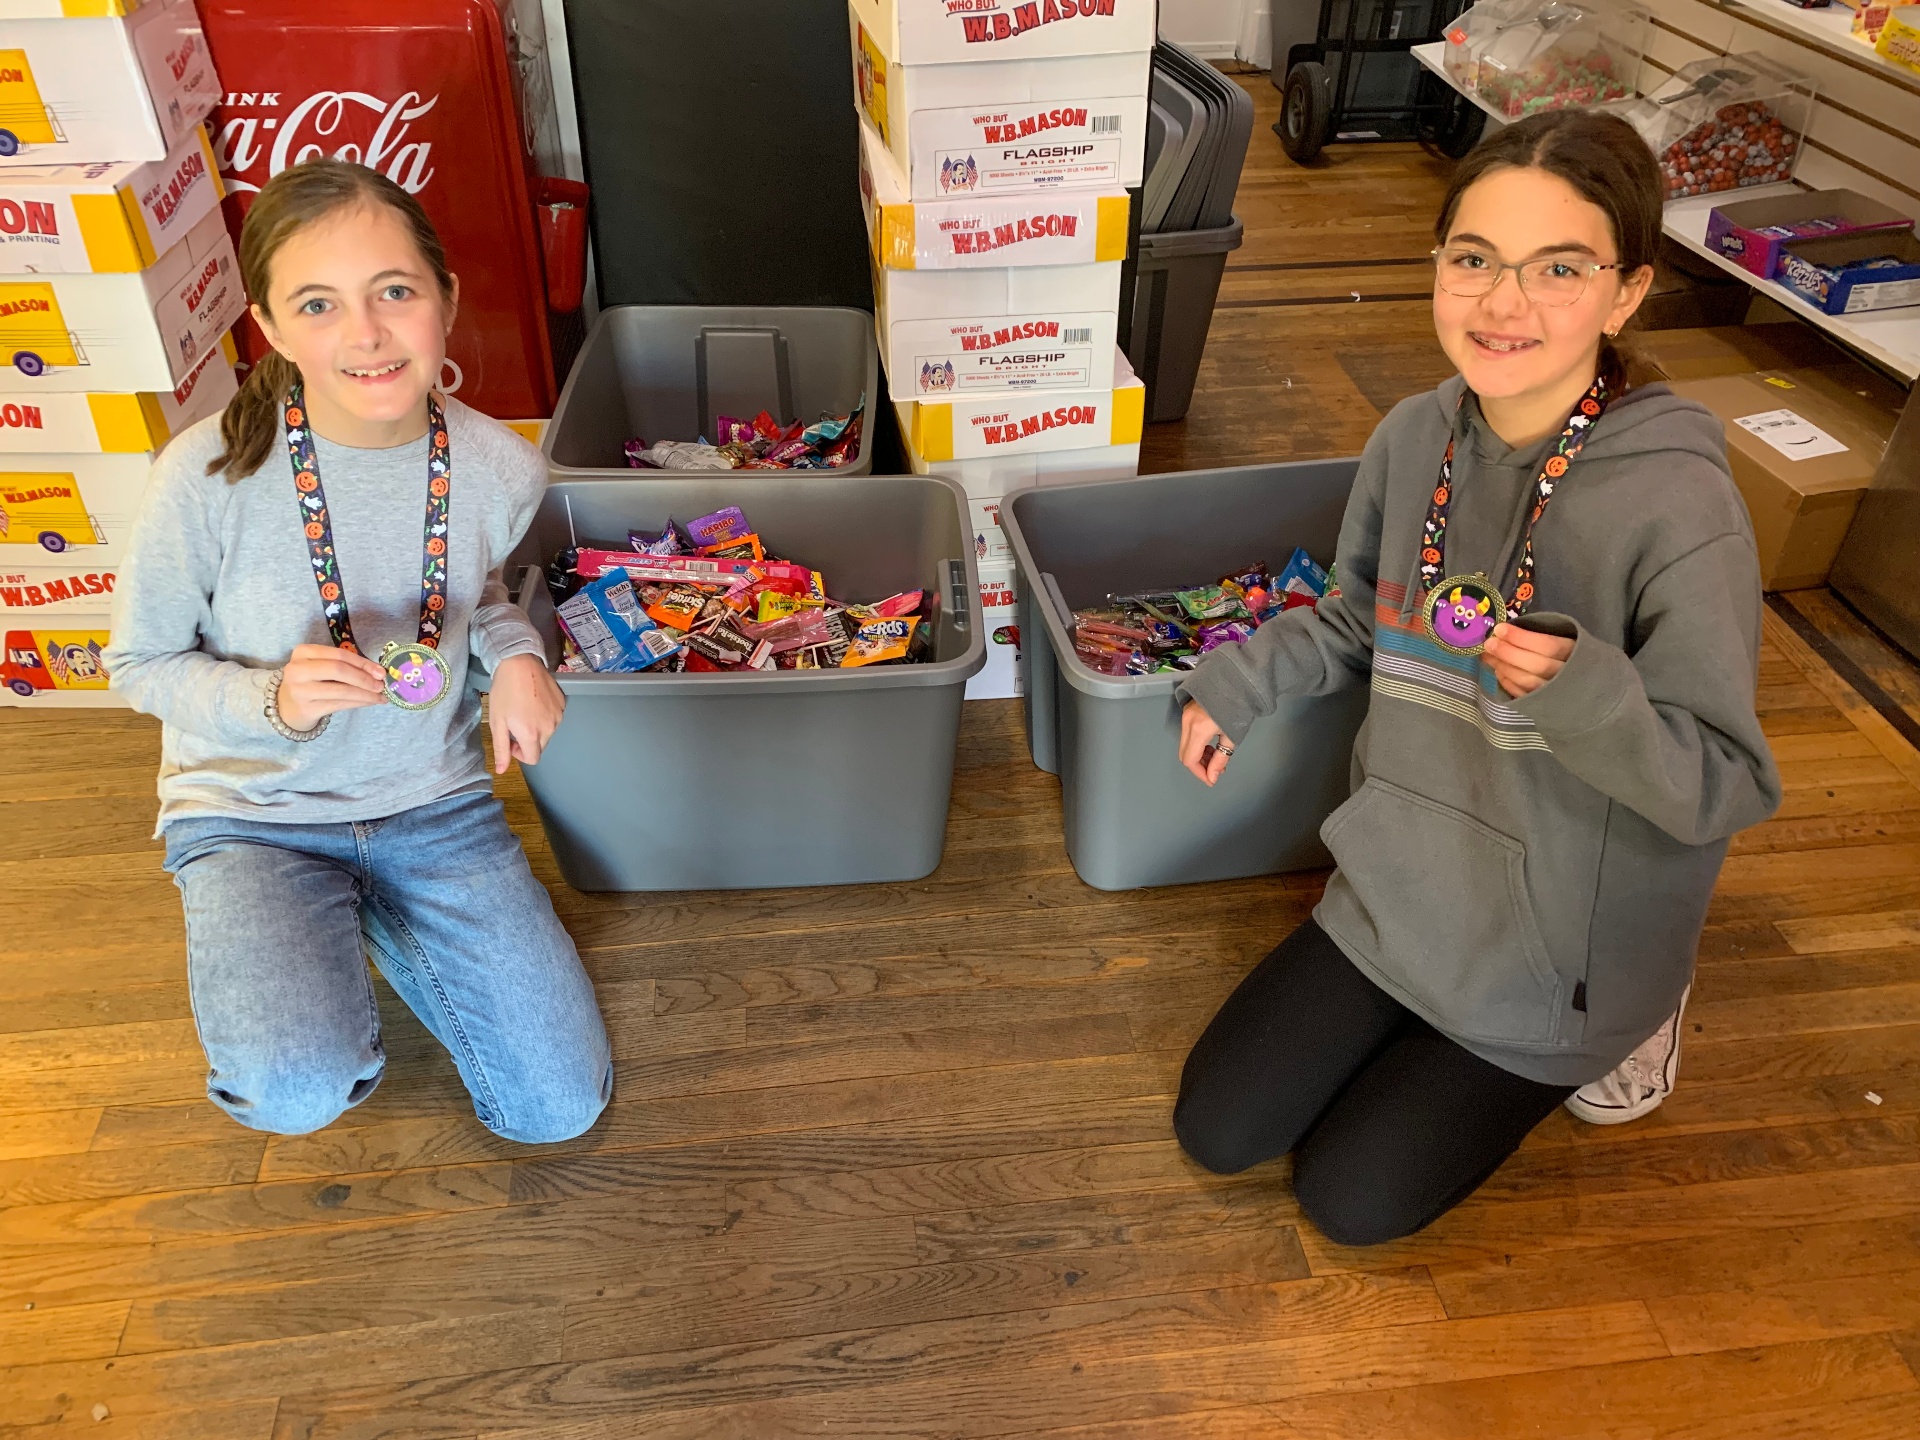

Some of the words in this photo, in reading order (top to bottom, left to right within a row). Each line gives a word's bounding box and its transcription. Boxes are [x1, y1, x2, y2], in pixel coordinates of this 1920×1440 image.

[947, 0, 972, 11] WHO
[973, 0, 995, 9] BUT
[962, 0, 1116, 43] W.B.MASON
[217, 92, 282, 106] INK
[973, 115, 992, 125] WHO
[993, 113, 1009, 122] BUT
[983, 107, 1088, 144] W.B.MASON
[1003, 145, 1094, 160] FLAGSHIP
[939, 221, 960, 232] WHO
[962, 219, 981, 229] BUT
[8, 234, 60, 245] PRINTING
[951, 214, 1077, 255] W.B.MASON
[950, 326, 968, 335] WHO
[969, 325, 984, 333] BUT
[960, 321, 1060, 351] W.B.MASON
[979, 353, 1065, 366] FLAGSHIP
[970, 415, 991, 426] WHO
[993, 413, 1009, 423] BUT
[983, 405, 1097, 445] W.B.MASON
[3, 486, 72, 504] W.B.MASON
[983, 504, 999, 512] WHO
[700, 516, 737, 538] HARIBO
[6, 575, 26, 583] BUT
[990, 582, 1005, 590] BUT
[0, 572, 116, 607] W.B.MASO
[810, 572, 824, 601] OTS
